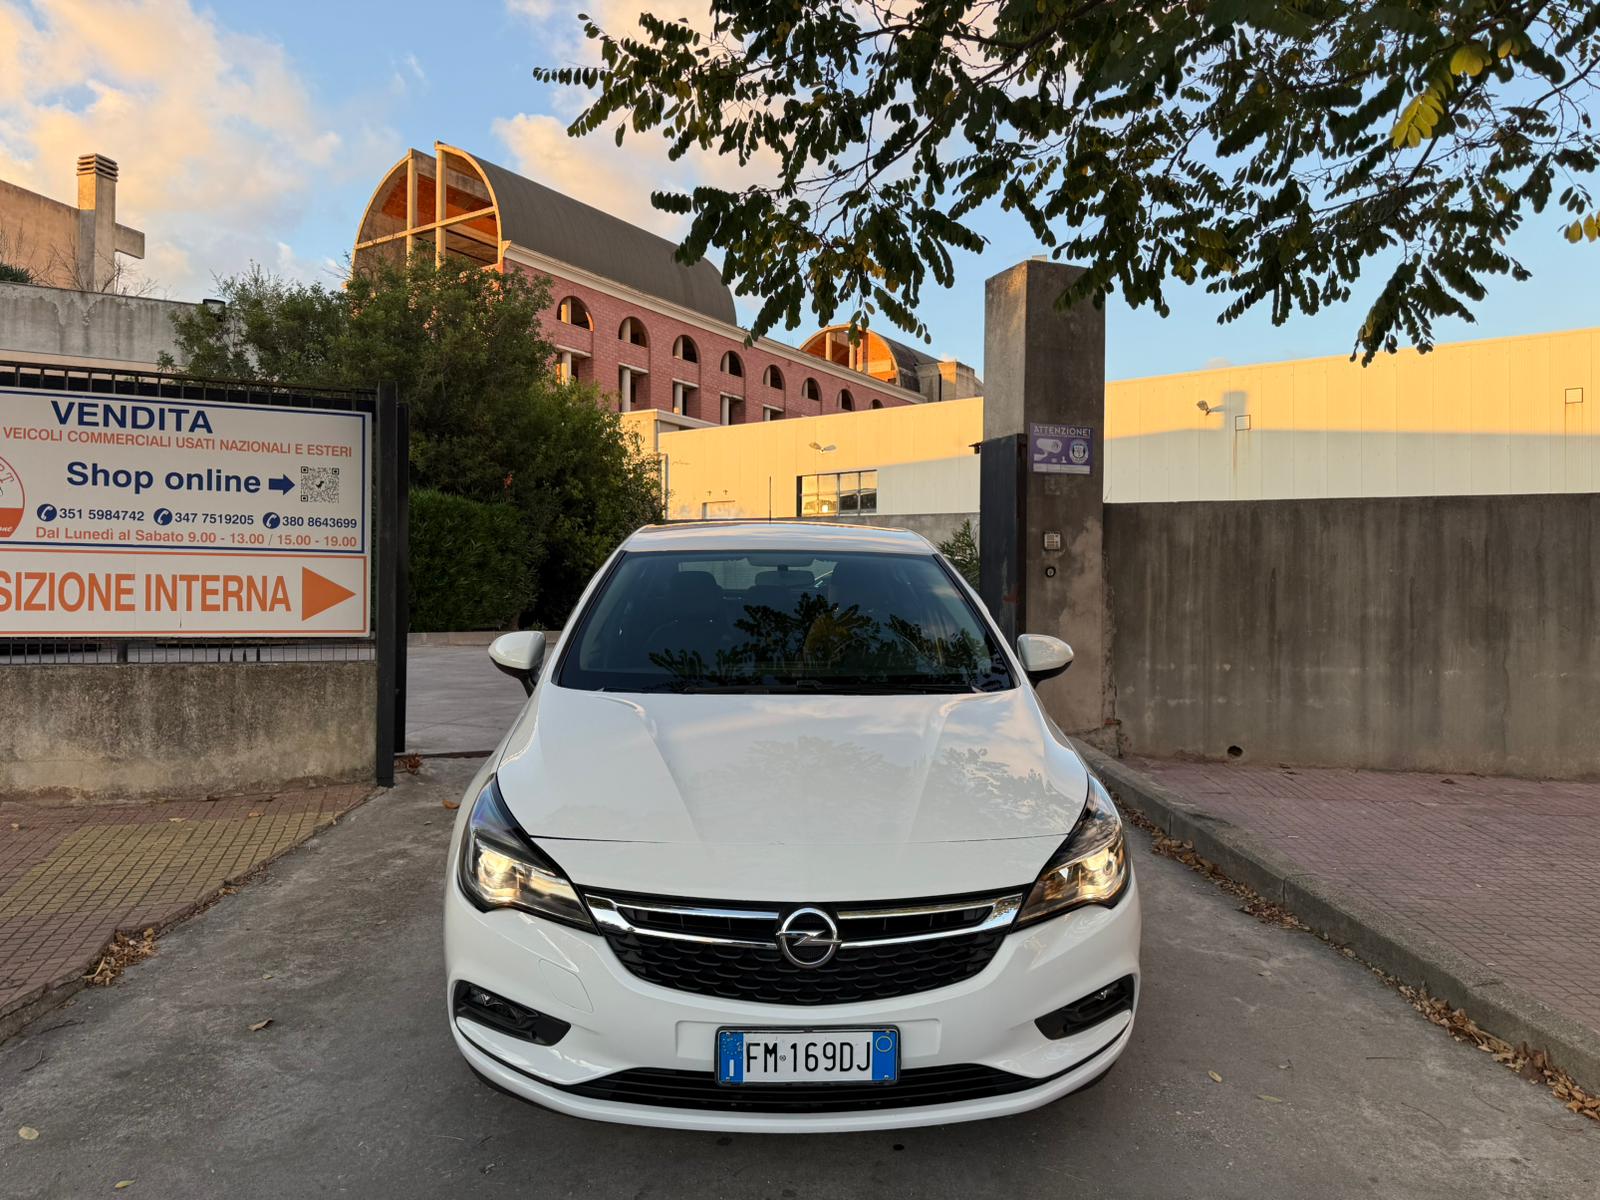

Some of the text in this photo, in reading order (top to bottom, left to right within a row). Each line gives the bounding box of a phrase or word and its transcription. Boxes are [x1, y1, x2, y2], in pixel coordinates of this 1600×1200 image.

[51, 400, 213, 434] VENDITA
[3, 427, 352, 457] VEICOLI COMMERCIALI USATI NAZIONALI E ESTERI
[67, 461, 261, 494] Shop online
[59, 508, 144, 521] 351 5984742
[175, 512, 254, 525] 347 7519205
[282, 516, 357, 529] 380 8643699
[36, 526, 59, 539] Dal
[65, 527, 114, 541] Lunedì
[118, 529, 130, 541] al
[135, 529, 184, 542] Sabato
[188, 531, 216, 544] 9.00
[230, 533, 265, 545] 13.00
[277, 534, 311, 545] 15.00
[324, 536, 357, 547] 19.00
[0, 571, 292, 612] SIZIONE INTERNA
